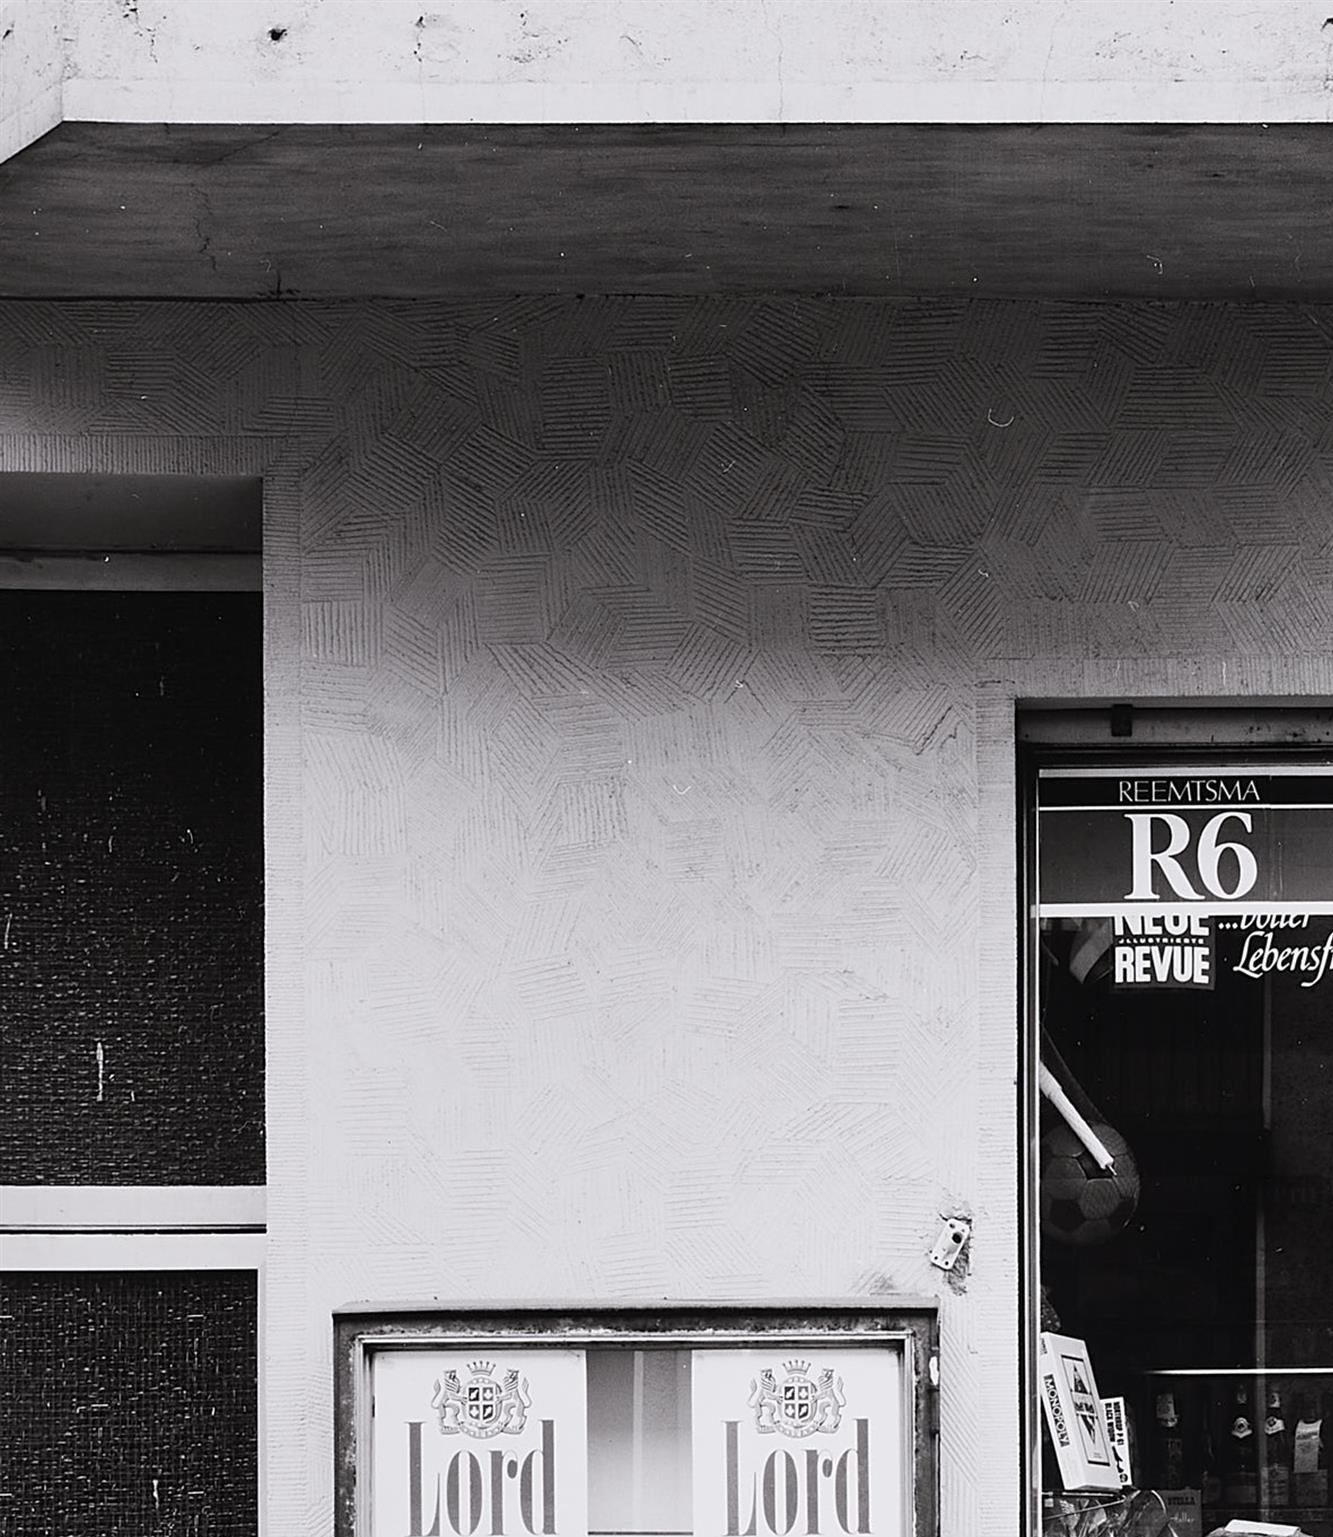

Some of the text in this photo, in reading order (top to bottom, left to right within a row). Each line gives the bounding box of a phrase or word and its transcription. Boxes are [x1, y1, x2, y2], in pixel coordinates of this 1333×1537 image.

[1119, 780, 1260, 802] REEMTSMA
[1123, 812, 1258, 900] R6
[1115, 946, 1210, 984] REVUE
[1043, 1374, 1071, 1447] MONOPOLY
[404, 1419, 559, 1537] Lord
[722, 1419, 874, 1537] Lord
